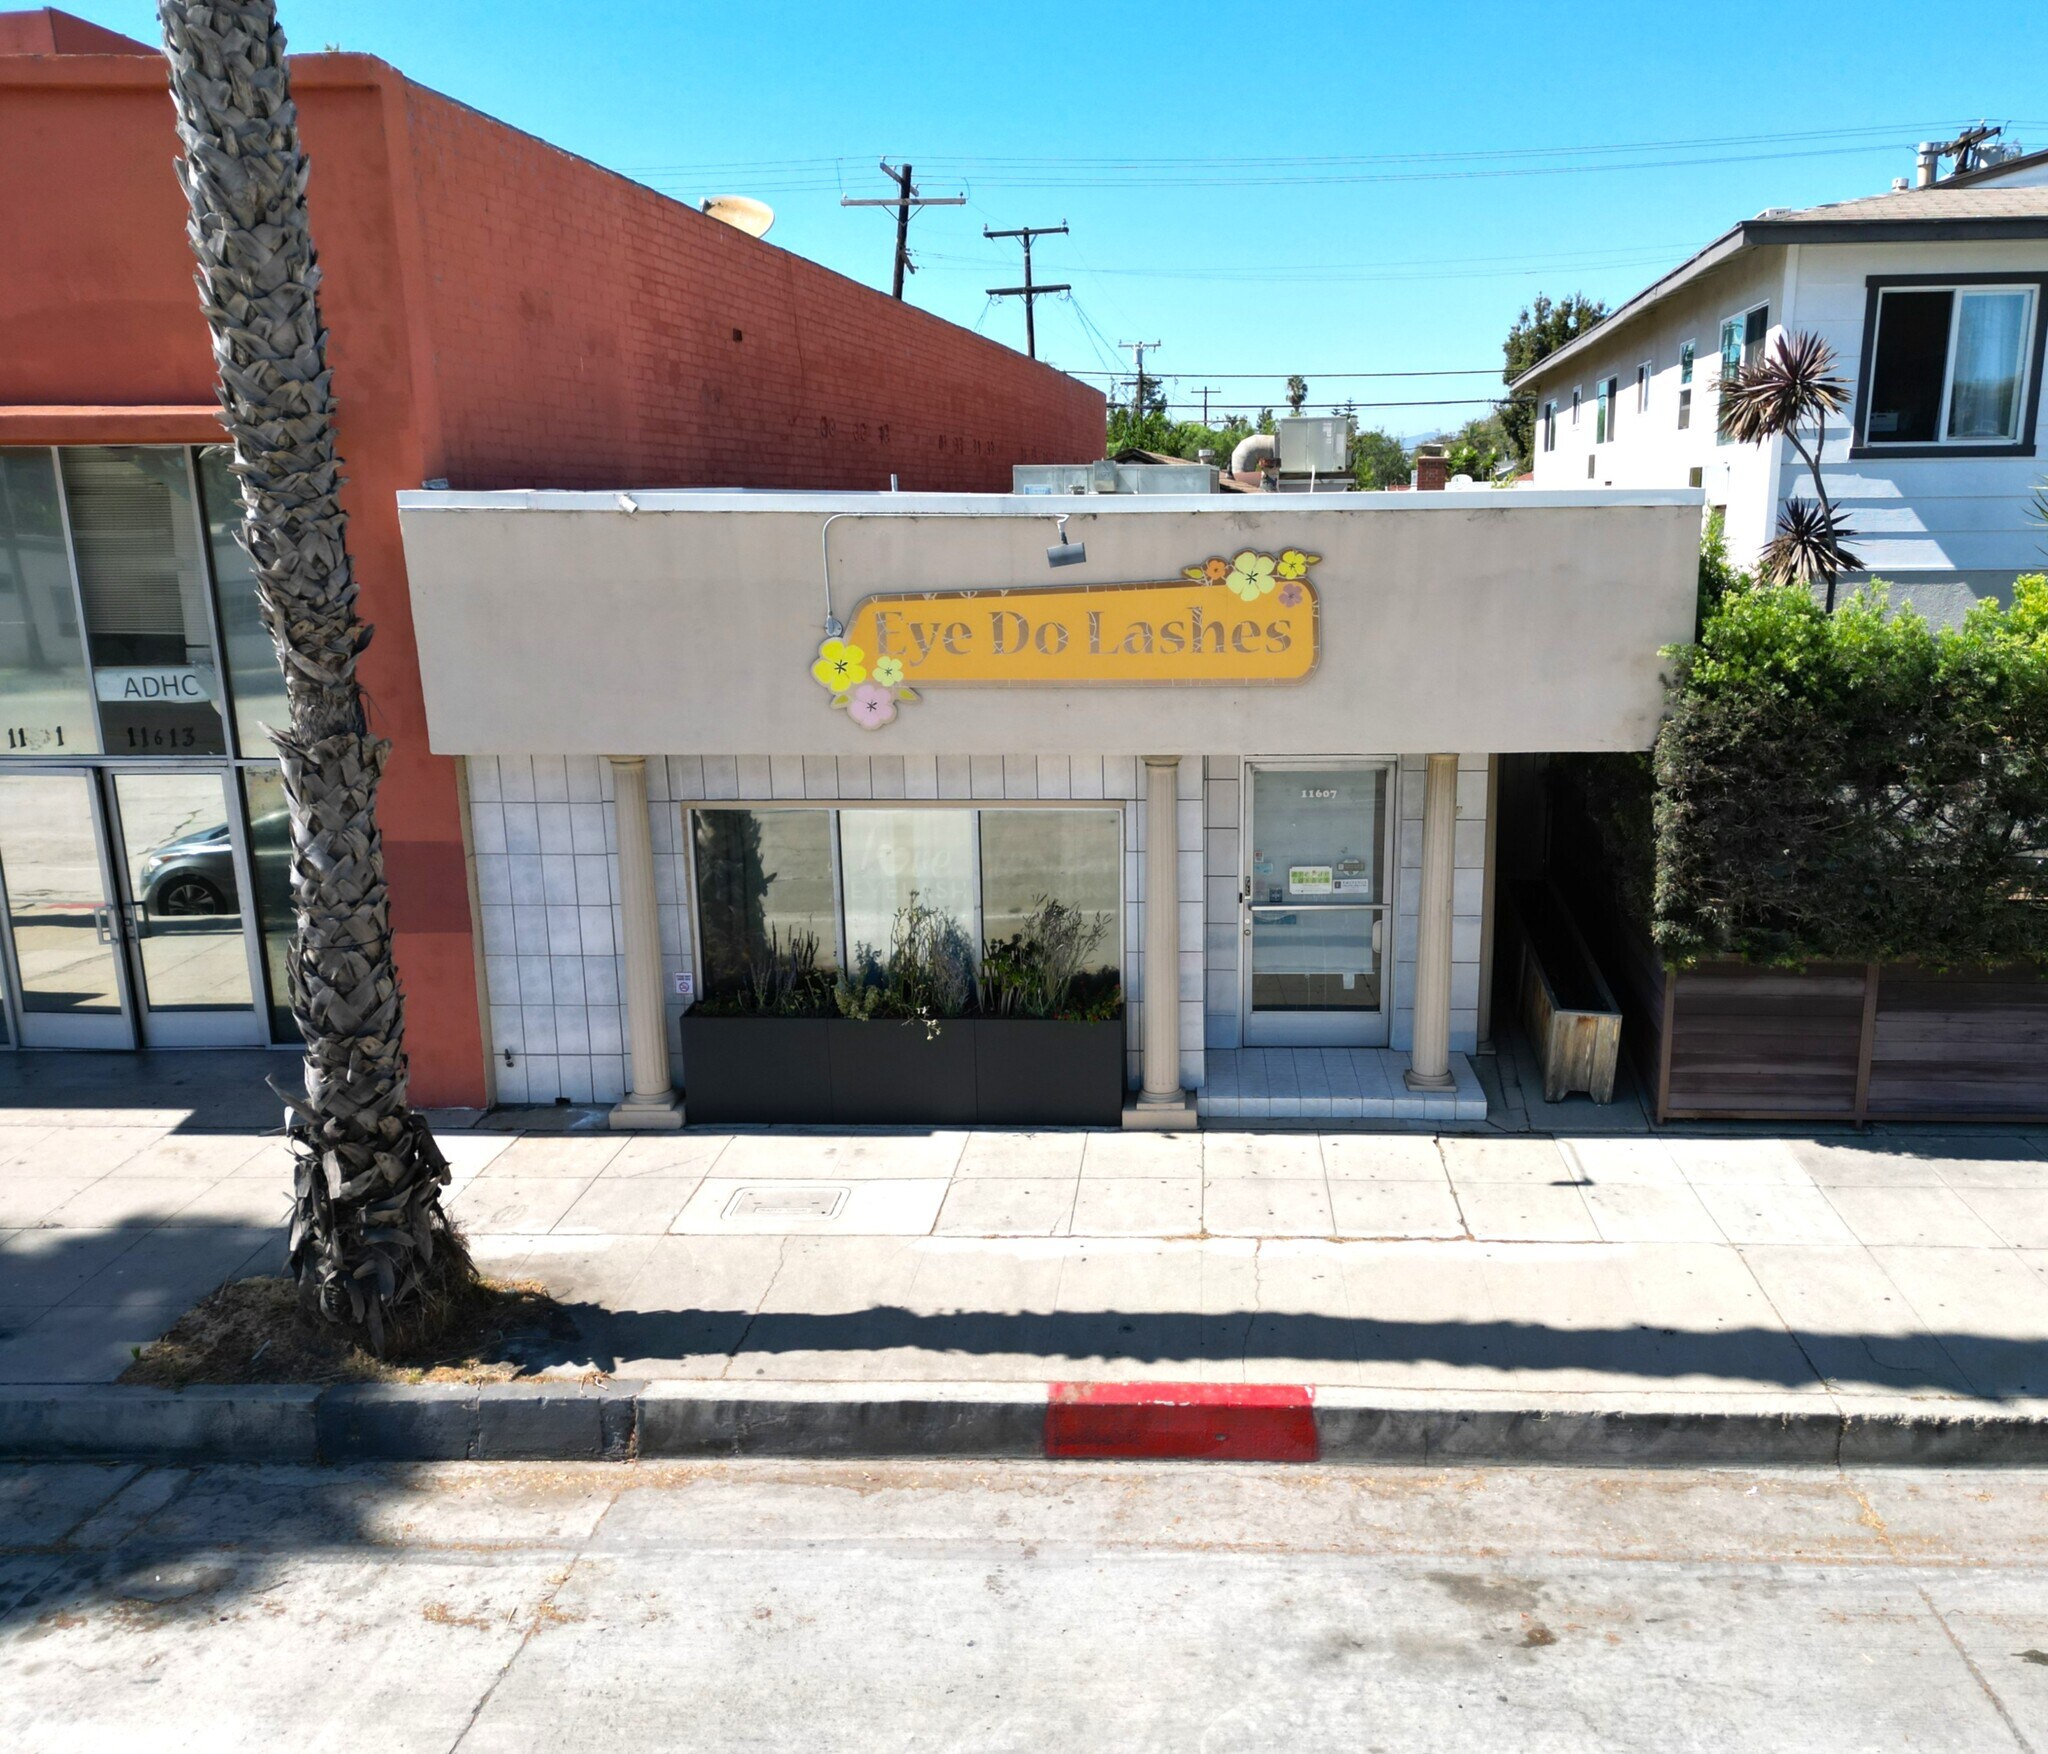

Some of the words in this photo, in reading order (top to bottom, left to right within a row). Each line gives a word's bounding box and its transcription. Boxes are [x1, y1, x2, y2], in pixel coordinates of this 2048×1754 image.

[874, 611, 973, 667] Eye
[989, 610, 1070, 655] Do
[1087, 606, 1293, 655] Lashes
[124, 674, 199, 698] ADHC
[127, 726, 196, 748] 11613
[1301, 789, 1338, 799] 11607
